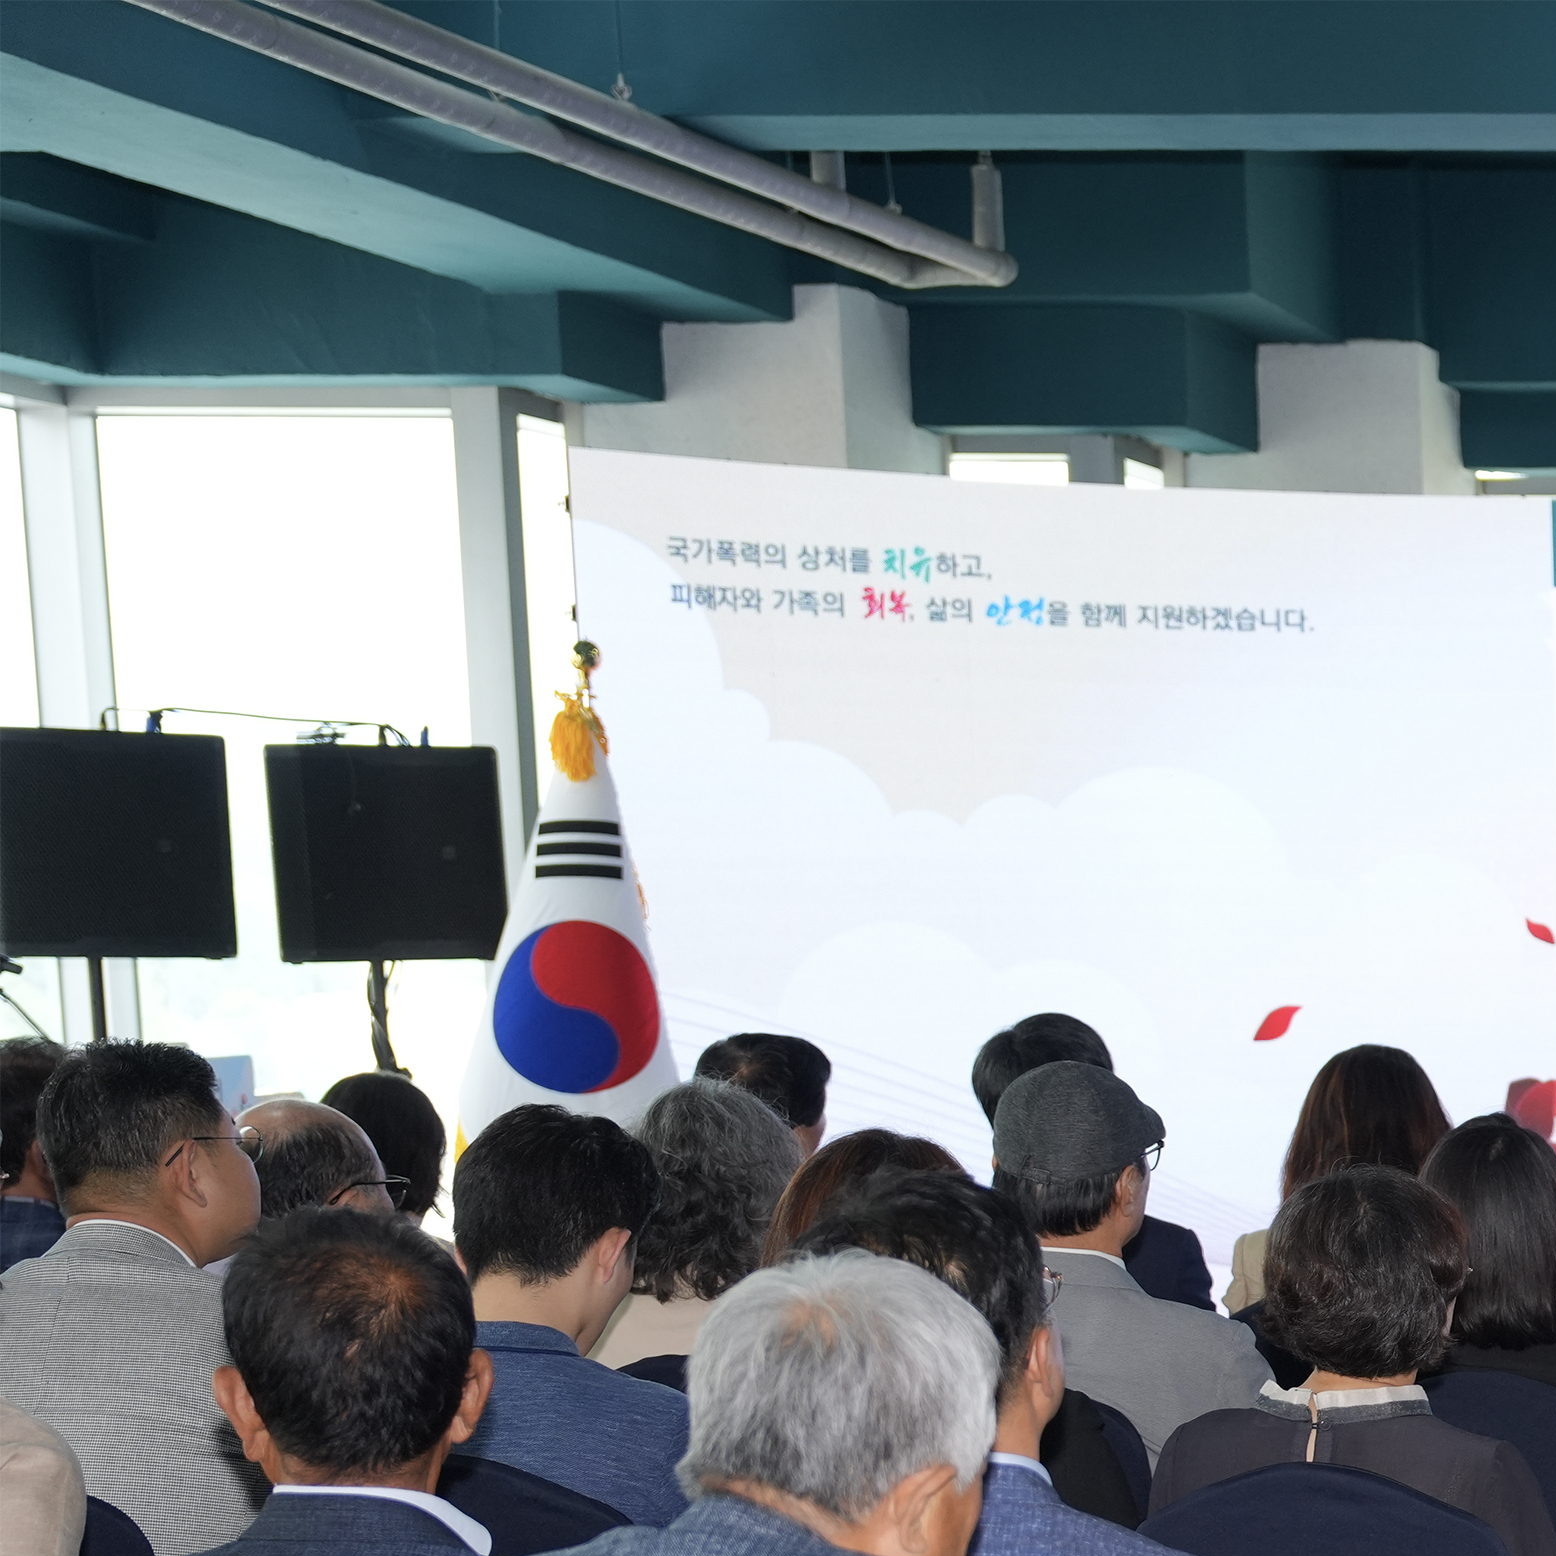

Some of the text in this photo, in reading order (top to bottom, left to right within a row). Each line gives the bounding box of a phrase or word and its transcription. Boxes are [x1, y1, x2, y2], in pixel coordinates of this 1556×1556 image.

[667, 536, 991, 583] 국가폭력의 상처를 치유하고,
[671, 583, 763, 613] 피해자와
[773, 589, 845, 618] 가족의
[926, 597, 973, 623] 삶의
[1080, 602, 1127, 628] 함께
[1137, 605, 1314, 632] 지원하겠습니다.
